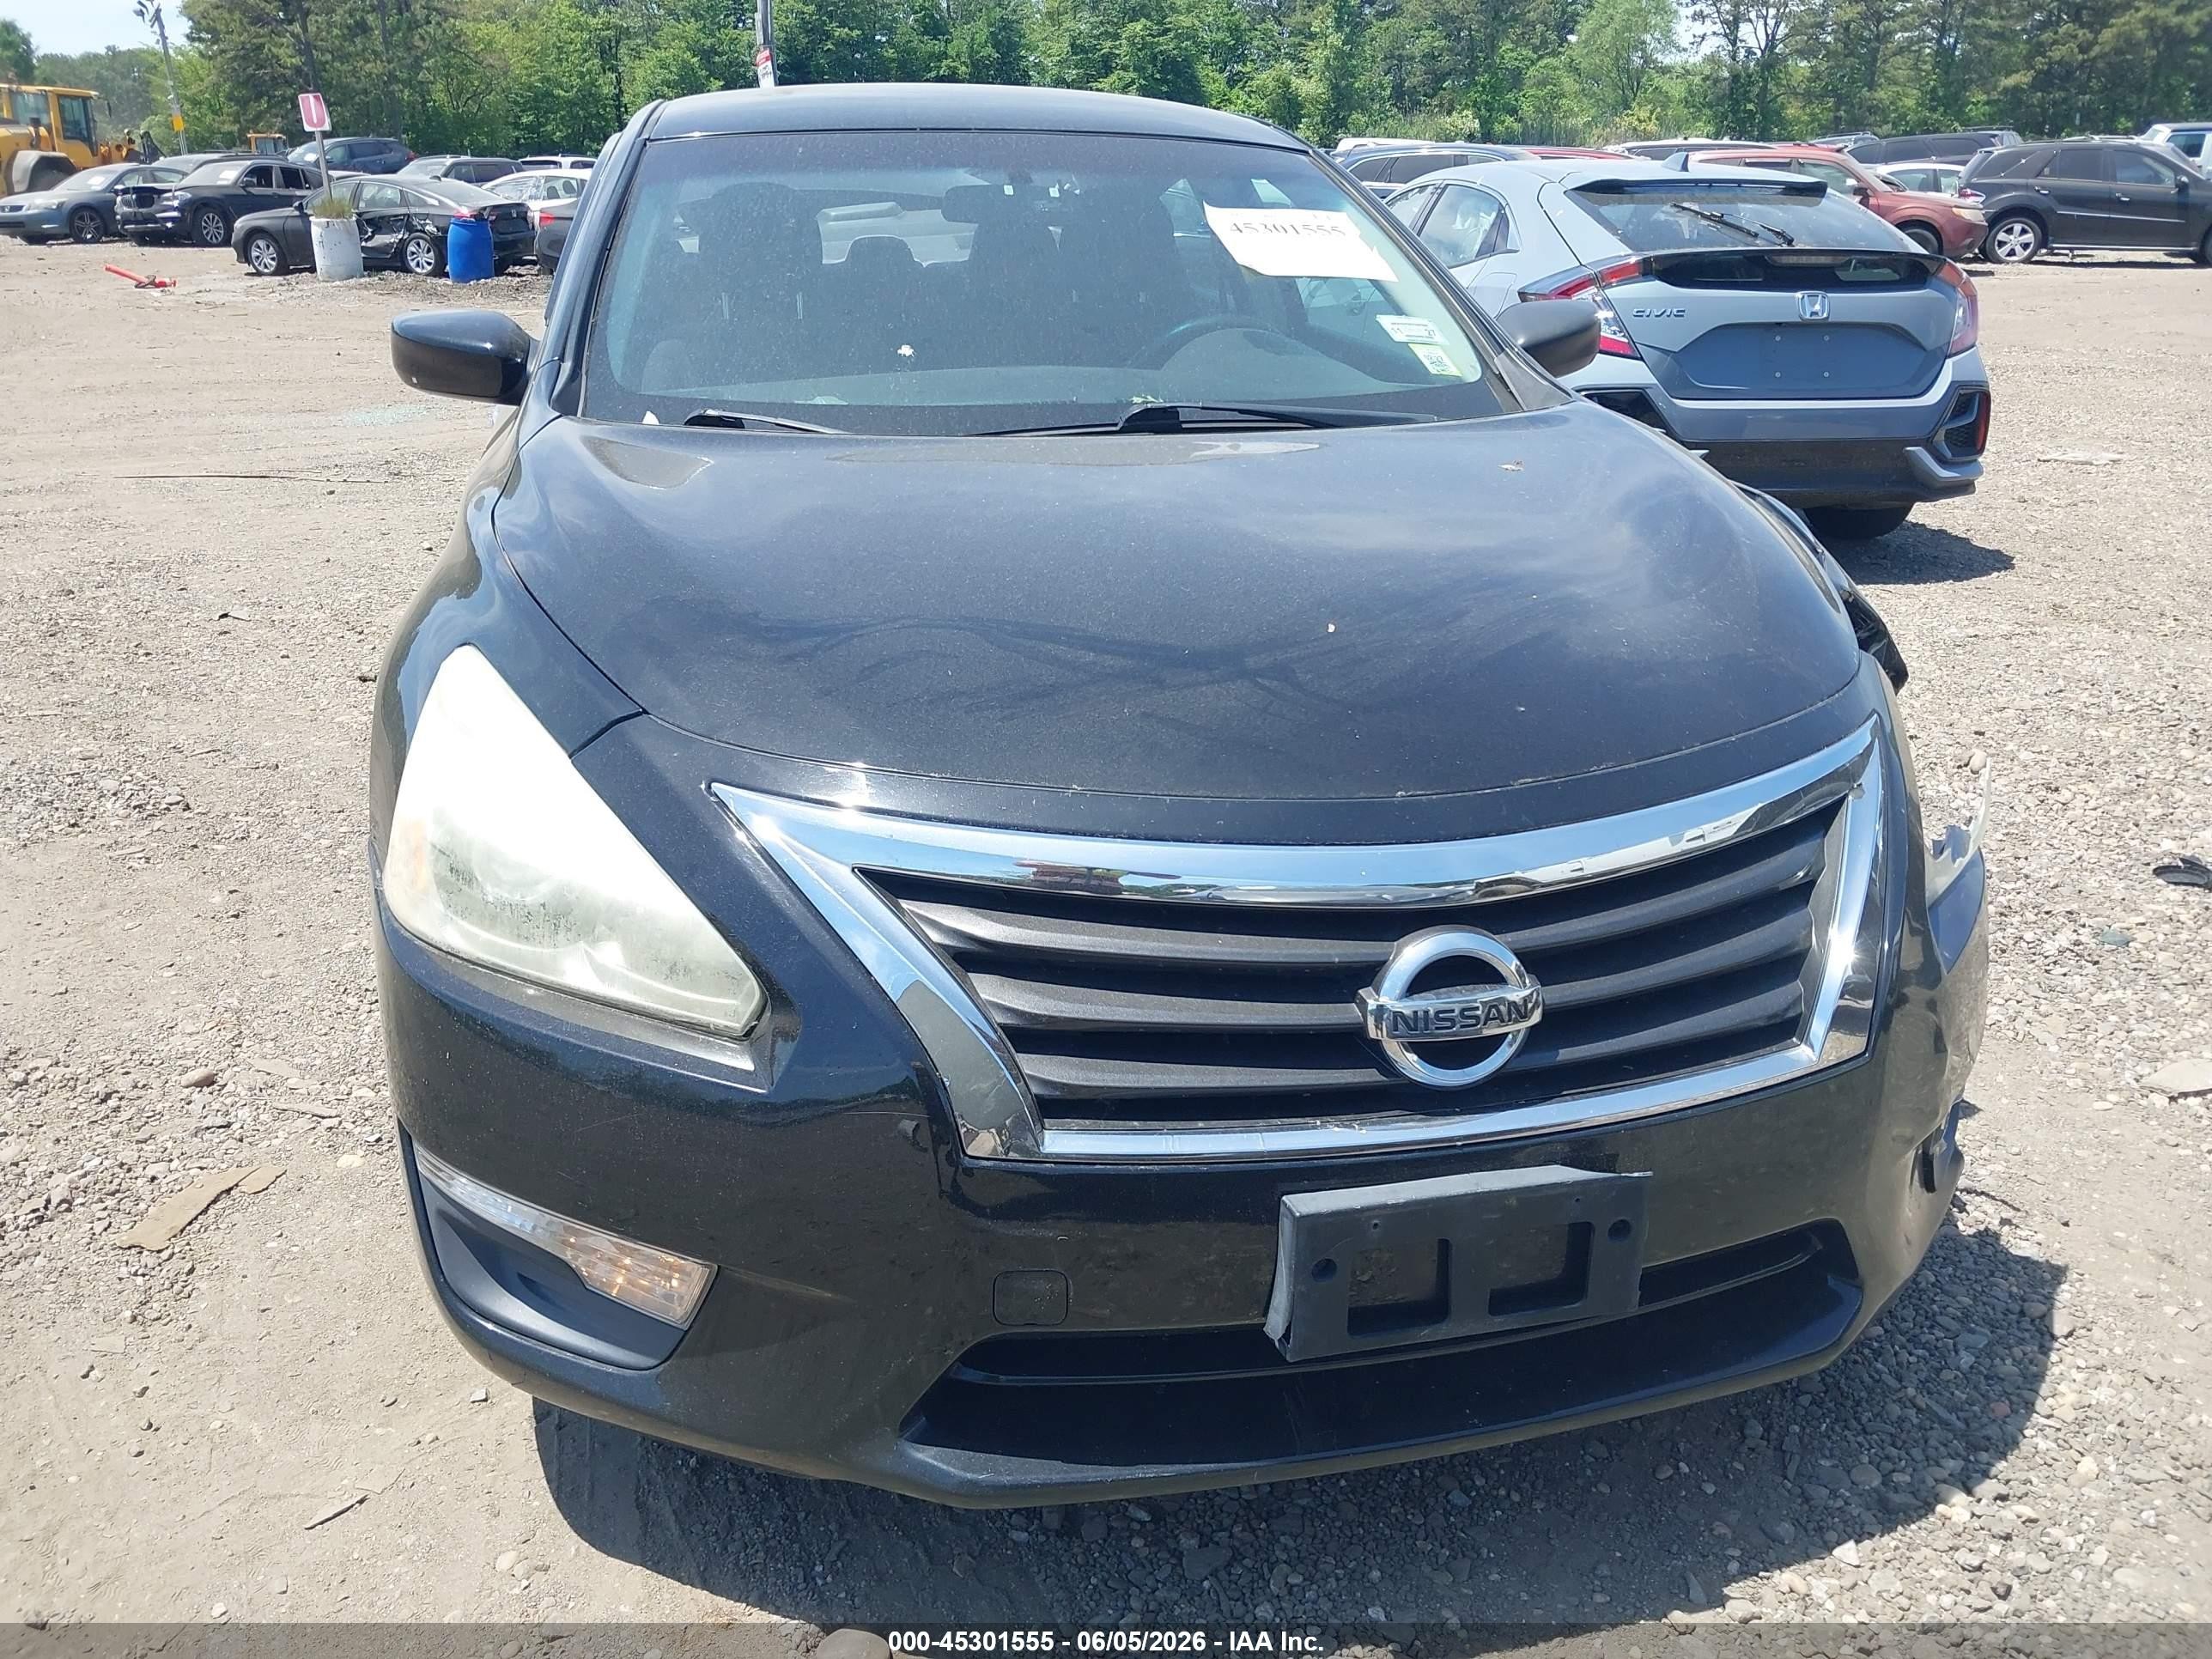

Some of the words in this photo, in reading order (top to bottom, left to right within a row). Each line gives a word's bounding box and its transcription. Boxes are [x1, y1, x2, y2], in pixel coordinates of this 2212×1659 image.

[1230, 222, 1346, 238] 45301555
[1632, 307, 1686, 319] CIVIC
[1391, 998, 1529, 1035] NISSAN
